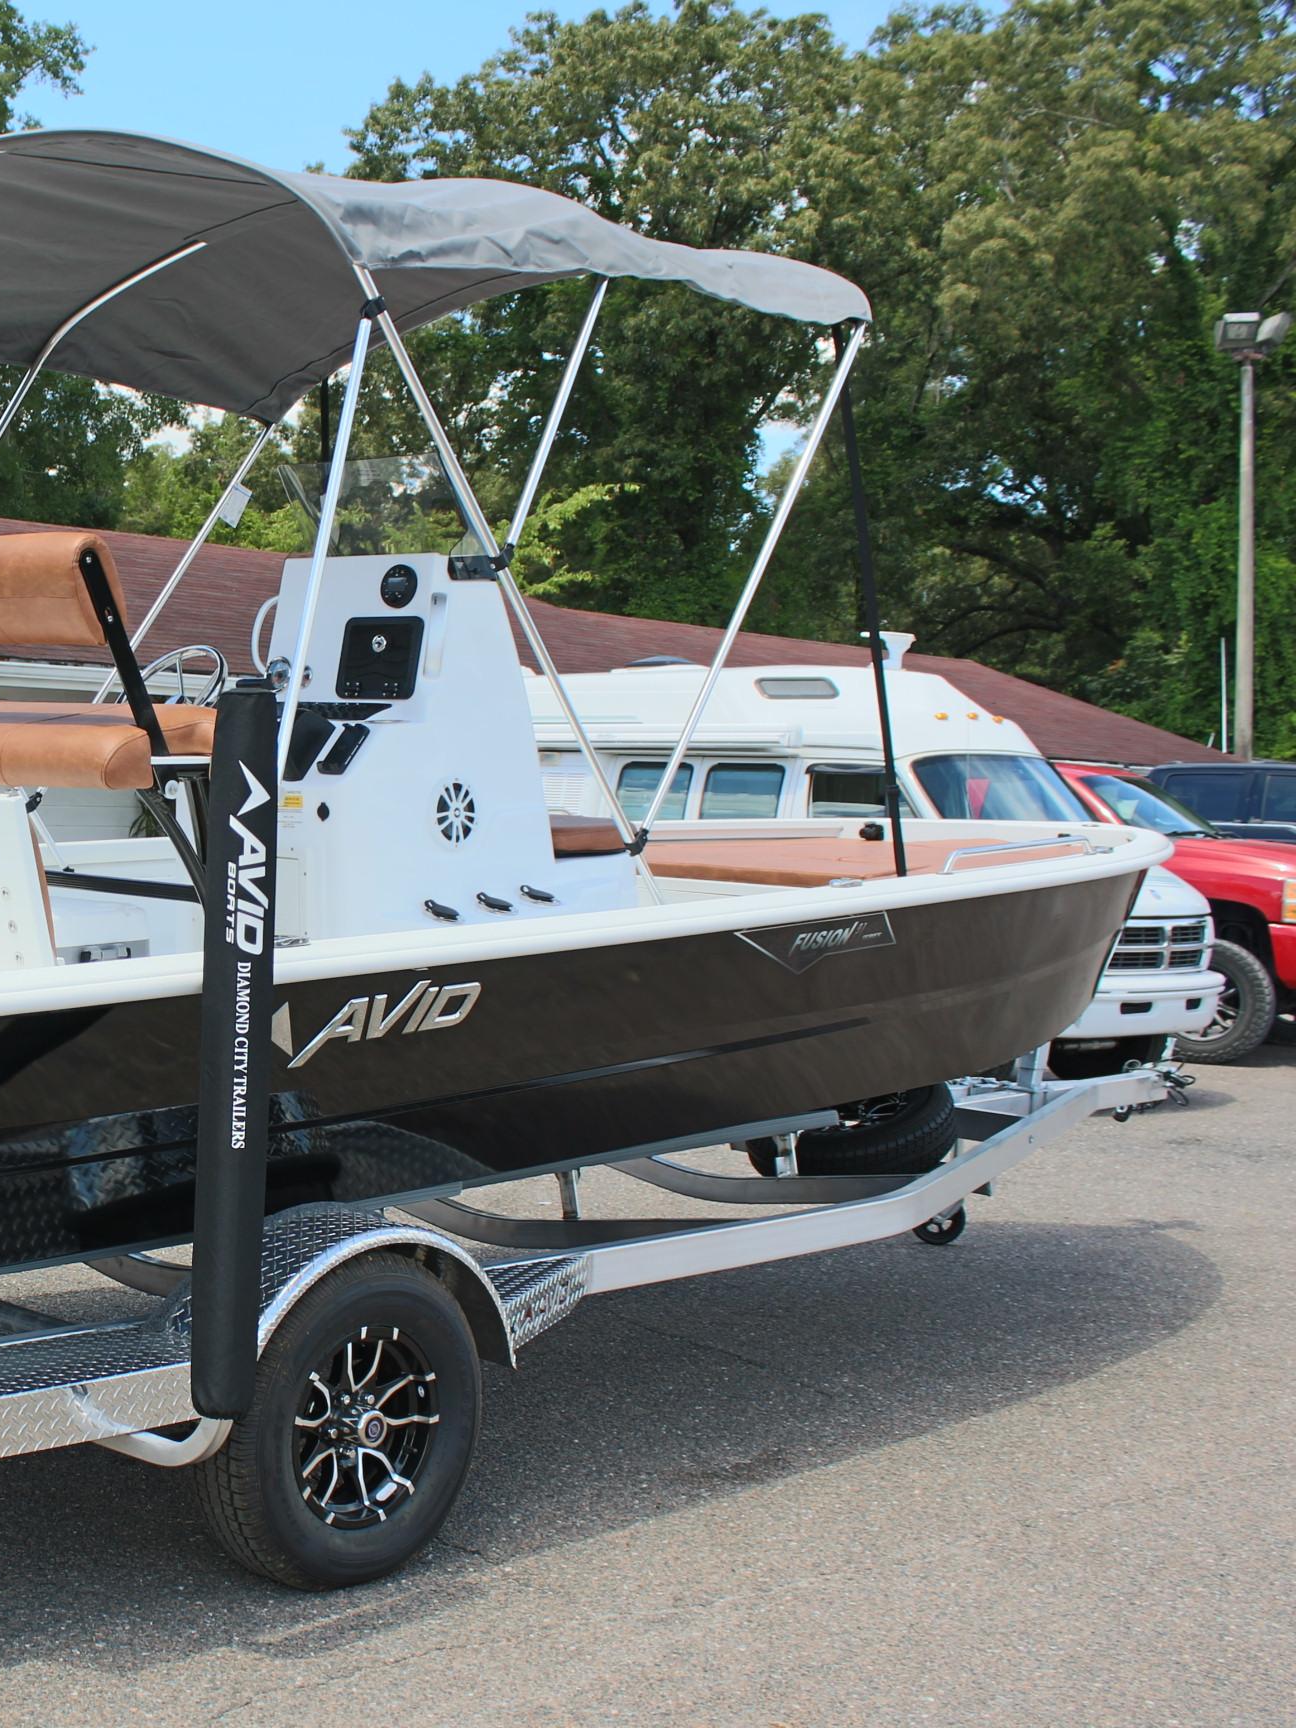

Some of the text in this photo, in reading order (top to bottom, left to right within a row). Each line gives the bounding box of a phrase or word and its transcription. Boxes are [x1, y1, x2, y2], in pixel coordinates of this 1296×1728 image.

[225, 861, 238, 945] BOATS
[229, 814, 269, 956] AVID
[789, 921, 859, 957] FUSION
[231, 961, 252, 1150] DIAMOND CITY TRAILERS
[287, 979, 482, 1069] AVID
